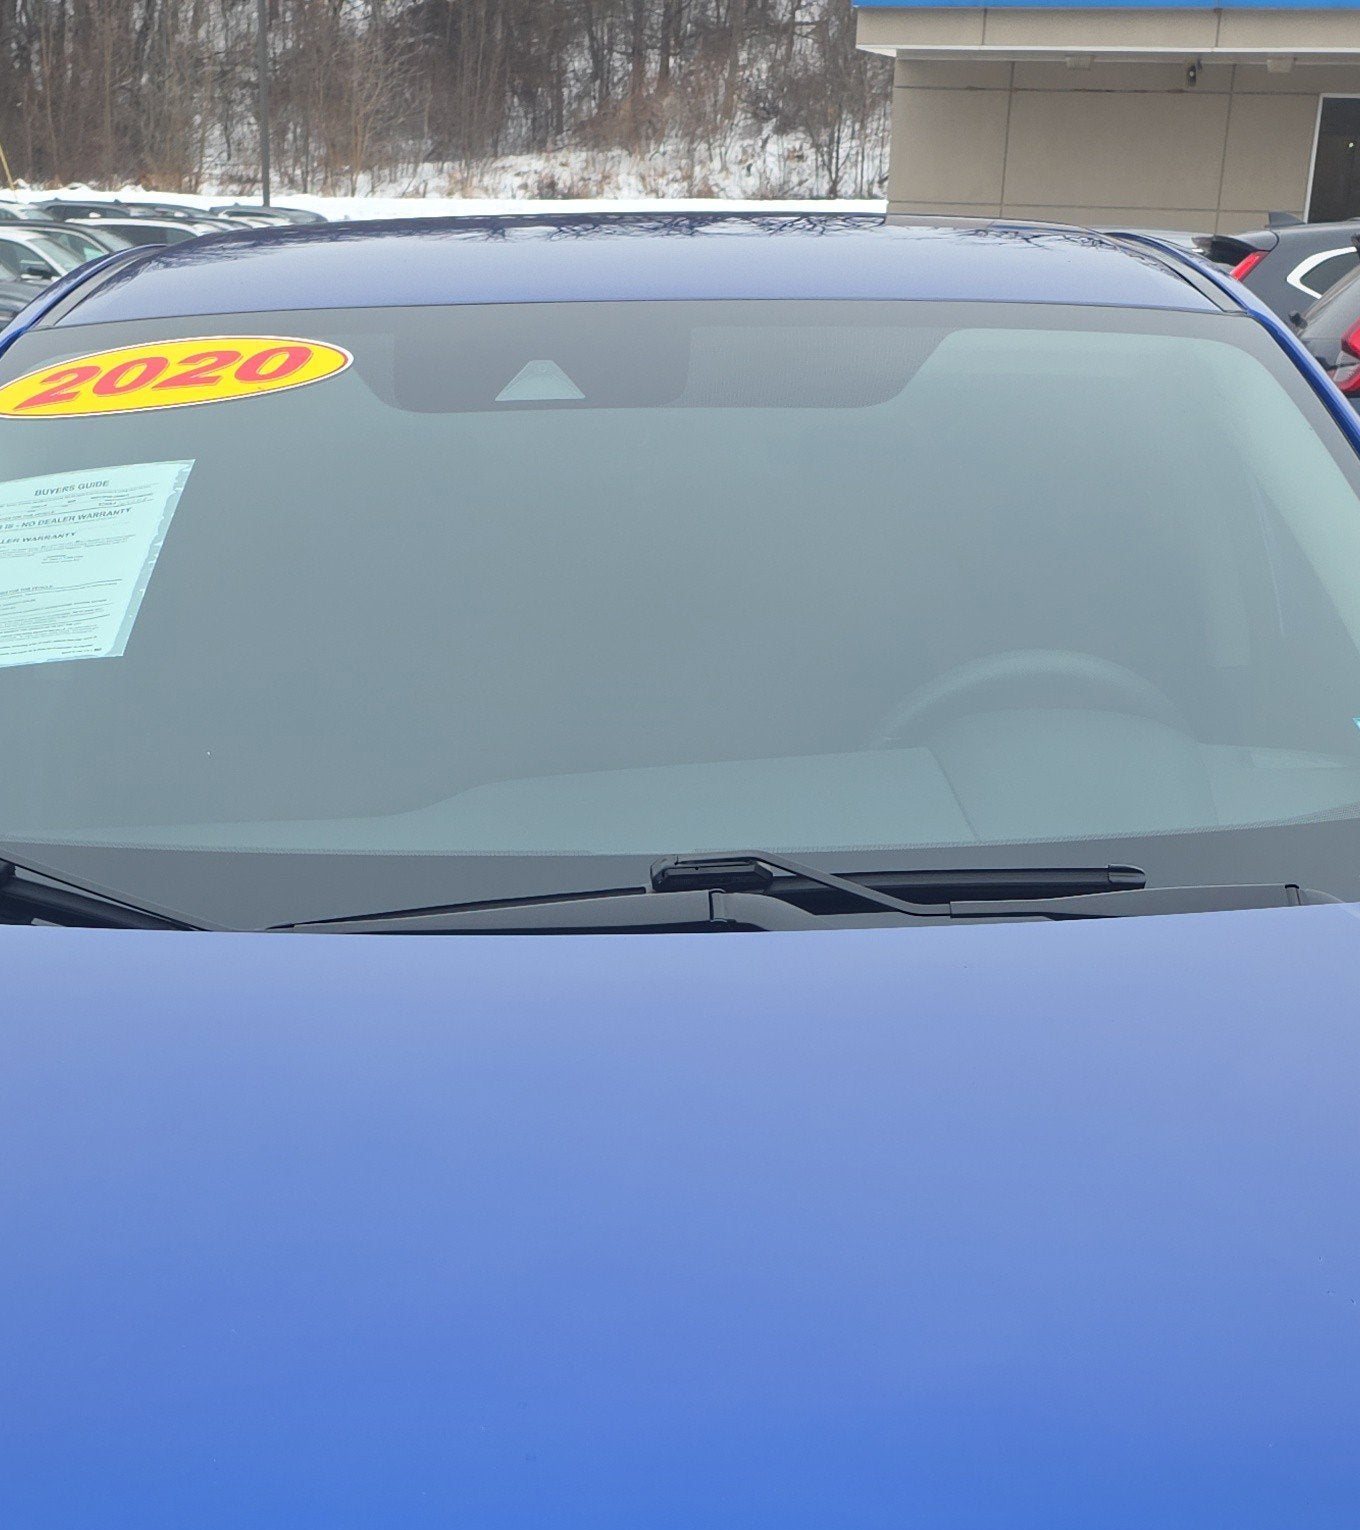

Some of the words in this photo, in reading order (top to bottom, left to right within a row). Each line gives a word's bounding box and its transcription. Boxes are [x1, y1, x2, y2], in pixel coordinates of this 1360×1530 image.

[12, 345, 314, 411] 2020
[34, 484, 75, 497] BUYERS
[77, 480, 110, 491] GUIDE
[21, 520, 36, 528] NO
[37, 514, 75, 525] DEALER
[77, 507, 132, 521] WARRANTY
[22, 532, 77, 543] WARRANTY
